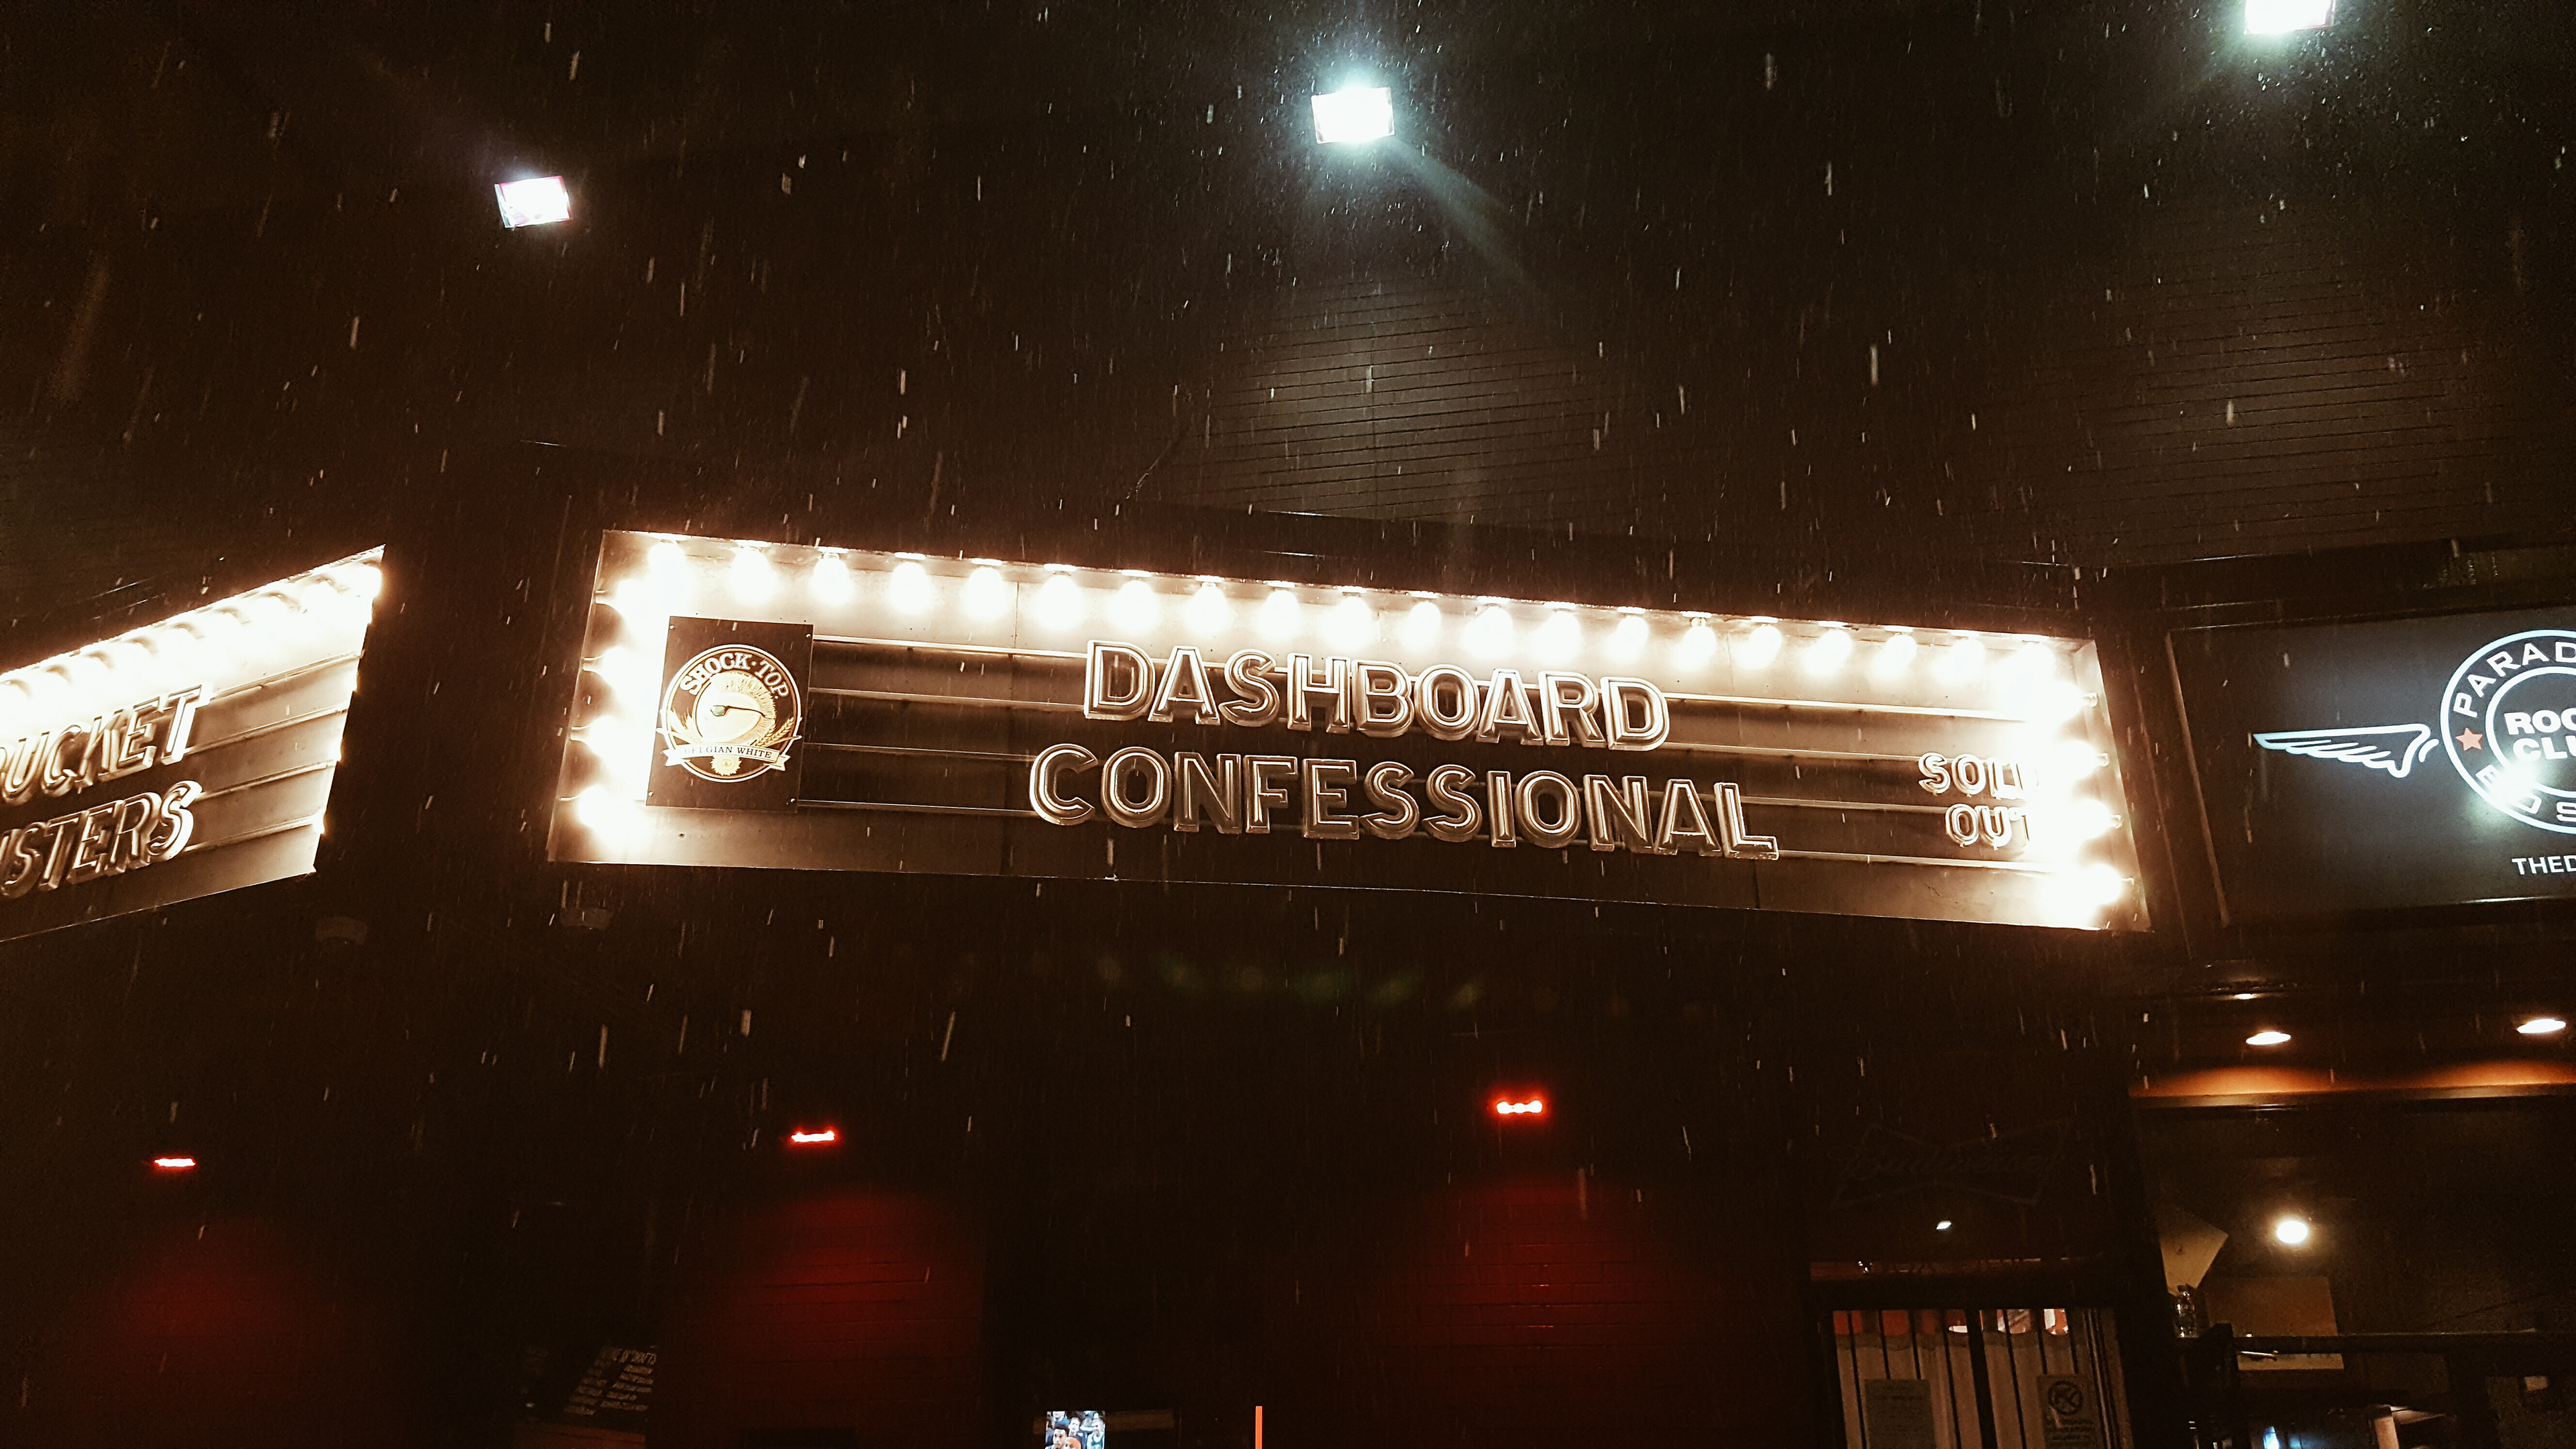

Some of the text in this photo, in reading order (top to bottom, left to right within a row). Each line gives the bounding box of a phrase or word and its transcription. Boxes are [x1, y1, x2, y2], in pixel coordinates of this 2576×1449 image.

[0, 684, 209, 806] UCKET
[1083, 639, 1670, 751] DASHBOARD
[737, 747, 773, 759] WHITE
[1028, 743, 1779, 861] CONFESSIONAL
